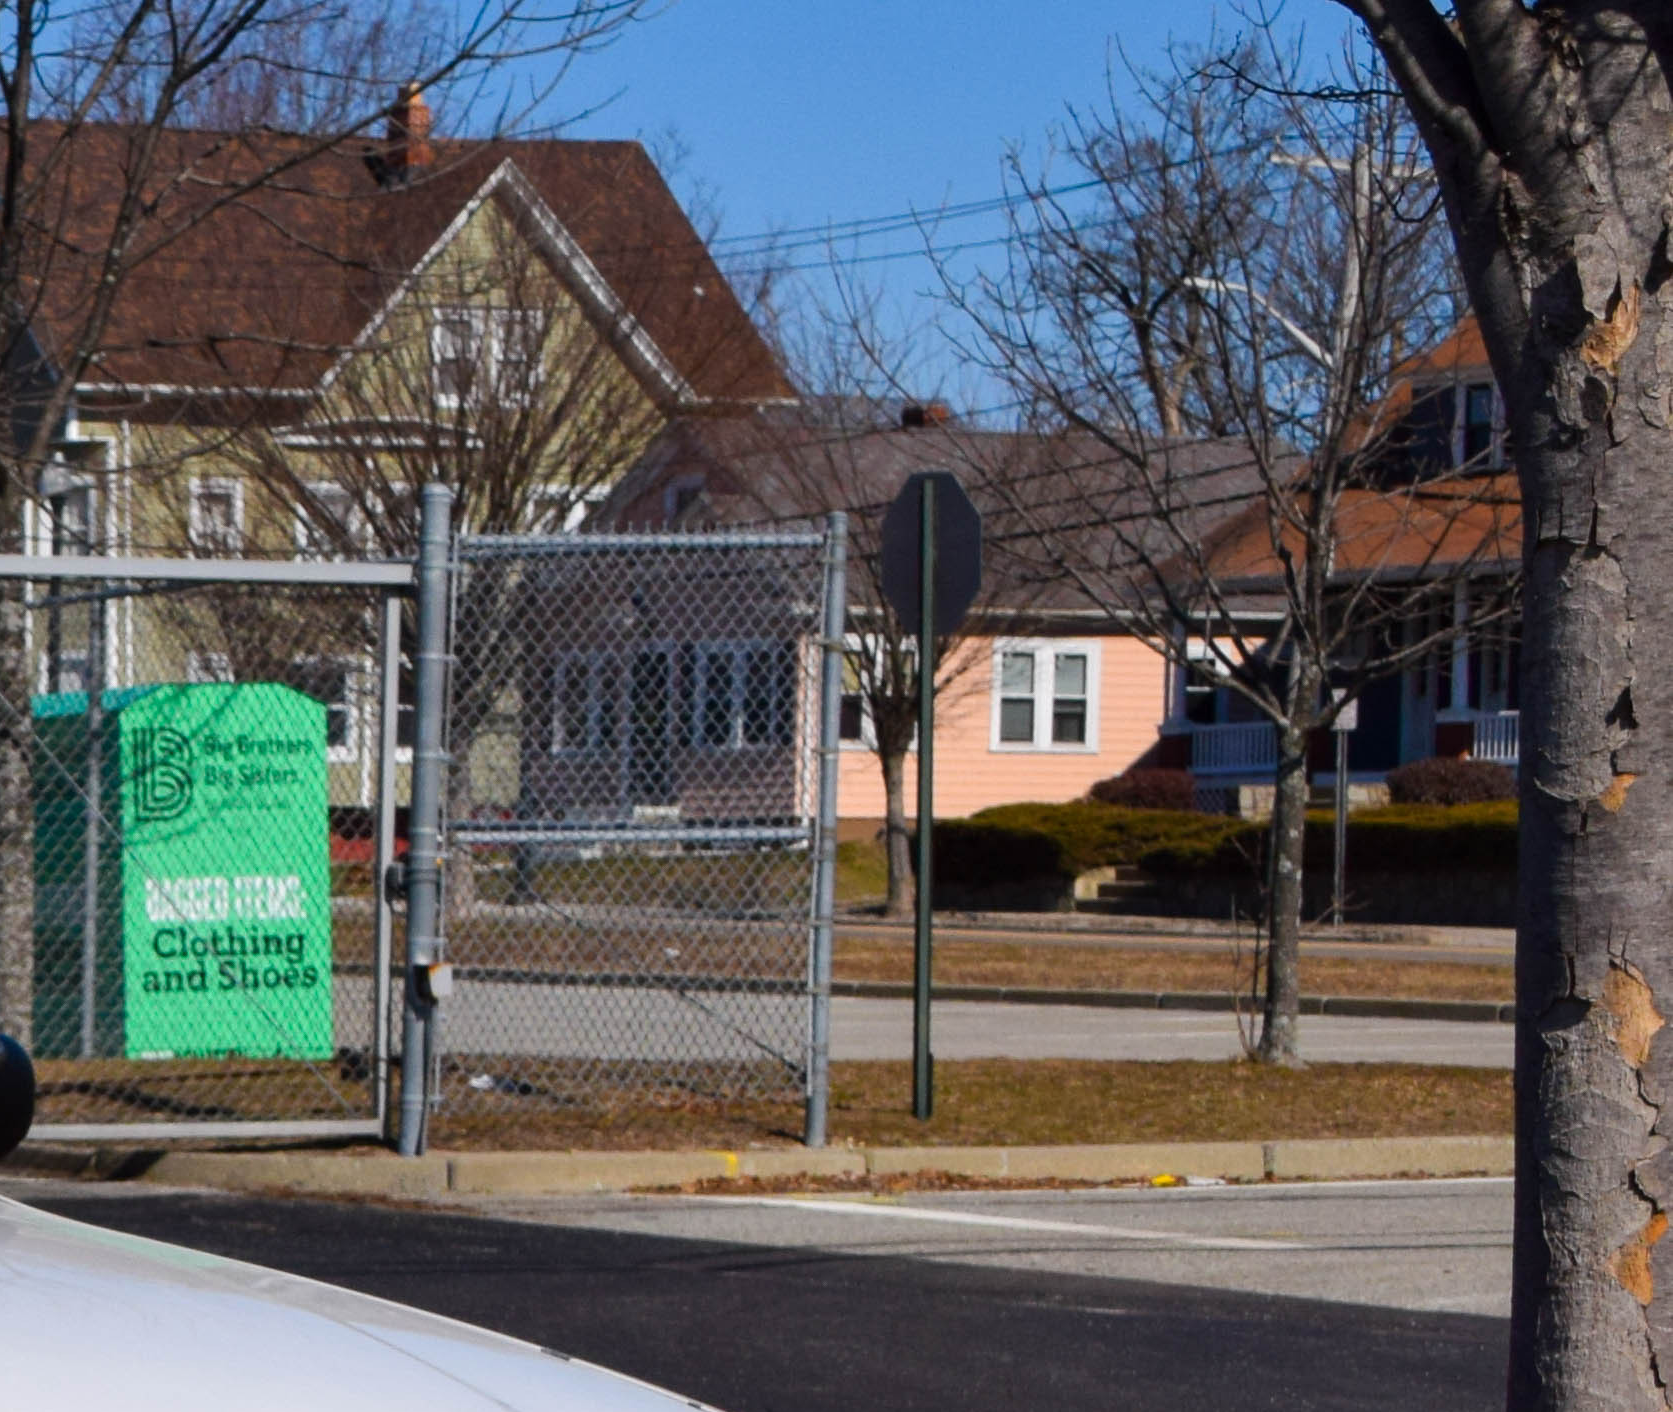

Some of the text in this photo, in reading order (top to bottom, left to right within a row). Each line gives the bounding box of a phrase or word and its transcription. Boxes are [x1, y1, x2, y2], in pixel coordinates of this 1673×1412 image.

[152, 926, 306, 963] Clothing
[142, 961, 318, 993] and Shoes
